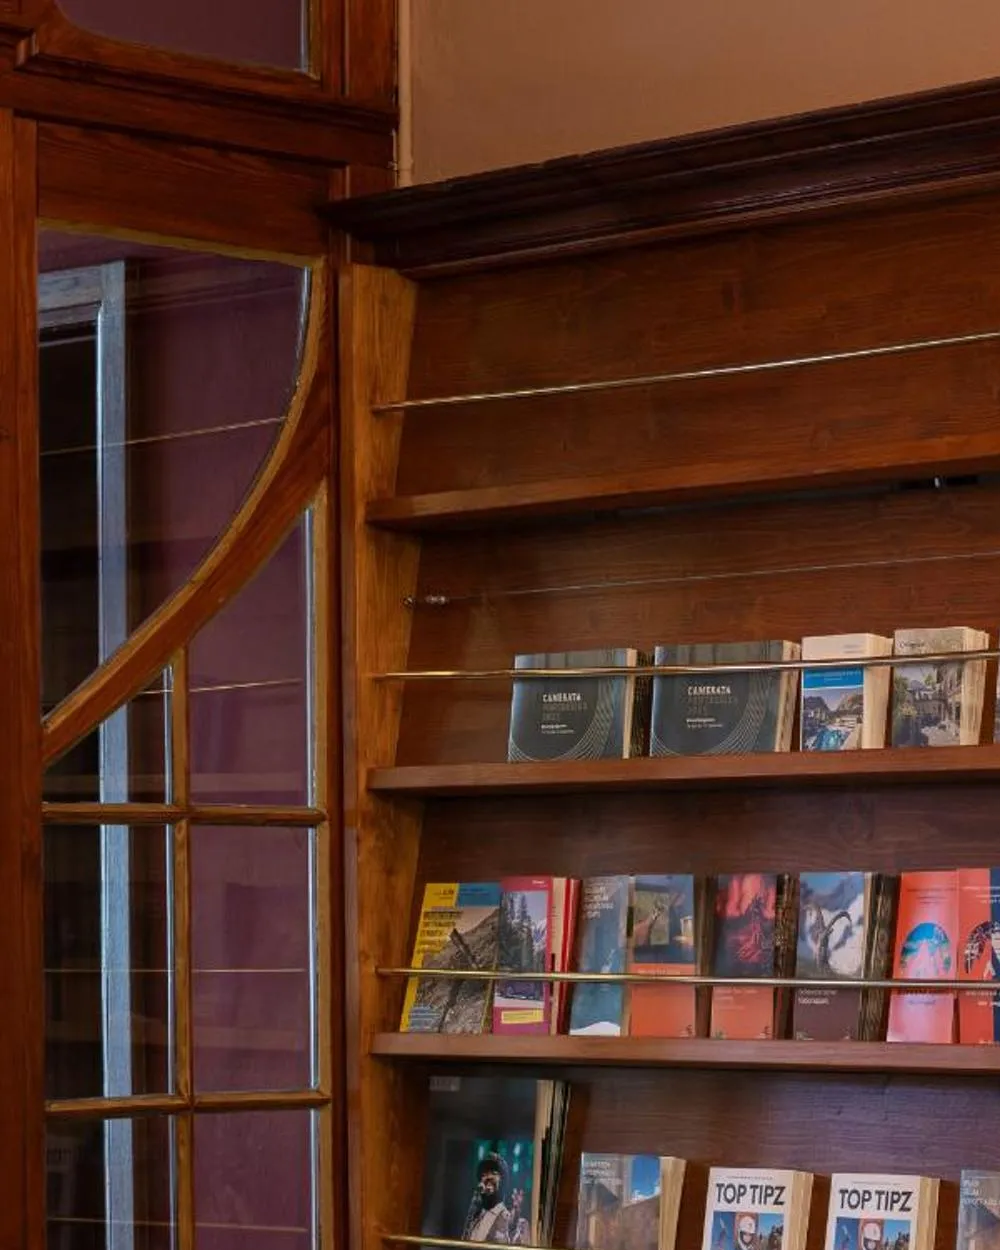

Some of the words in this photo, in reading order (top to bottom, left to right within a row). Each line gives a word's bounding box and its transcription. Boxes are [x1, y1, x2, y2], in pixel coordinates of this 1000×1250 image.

[716, 1182, 747, 1204] TOP
[750, 1184, 786, 1206] TIPZ
[839, 1189, 872, 1210] TOP
[875, 1190, 913, 1212] TIPZ
